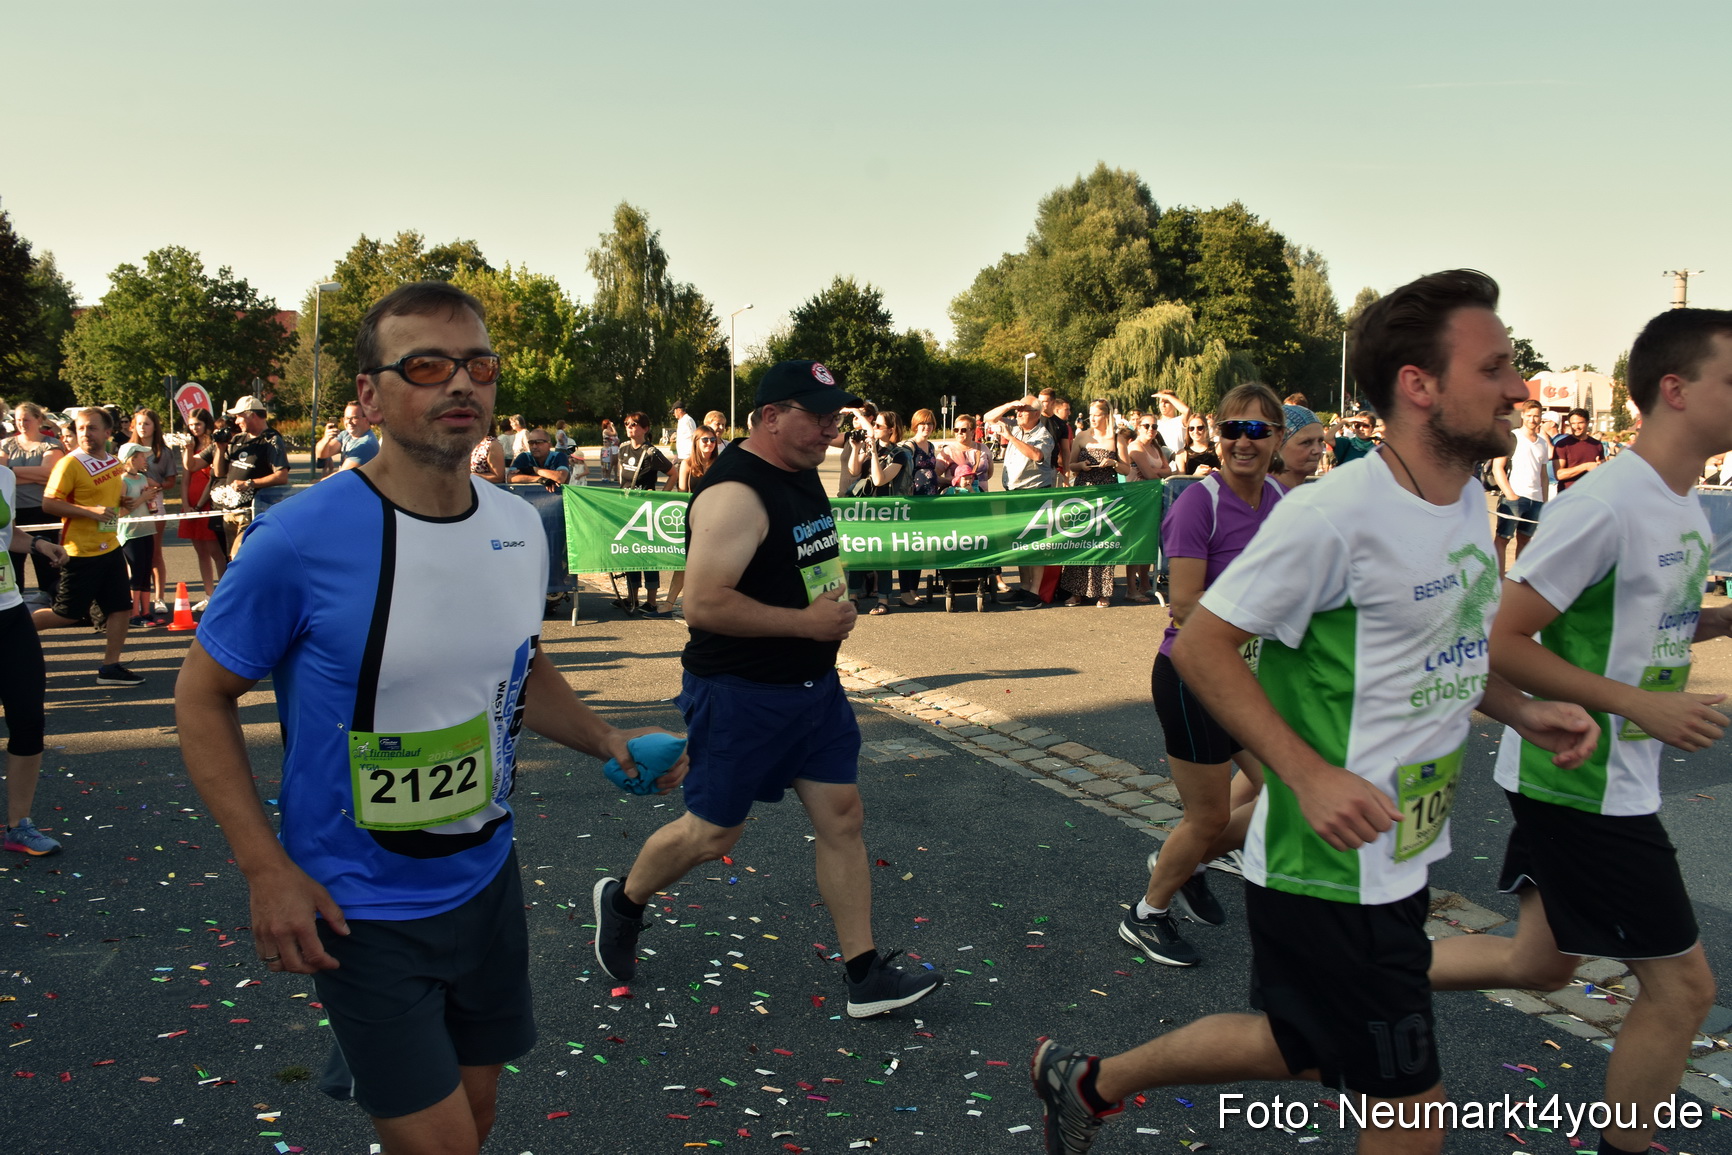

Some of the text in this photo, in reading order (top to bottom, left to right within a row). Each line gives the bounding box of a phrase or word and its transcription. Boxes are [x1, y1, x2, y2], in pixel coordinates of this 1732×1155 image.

[93, 473, 112, 486] MAX
[1016, 496, 1124, 539] AOK
[892, 530, 988, 552] Händen
[1012, 539, 1122, 551] Die Gesundheitskasse.
[611, 543, 629, 554] Die
[370, 748, 422, 758] firmenlauf
[370, 756, 478, 804] 2122
